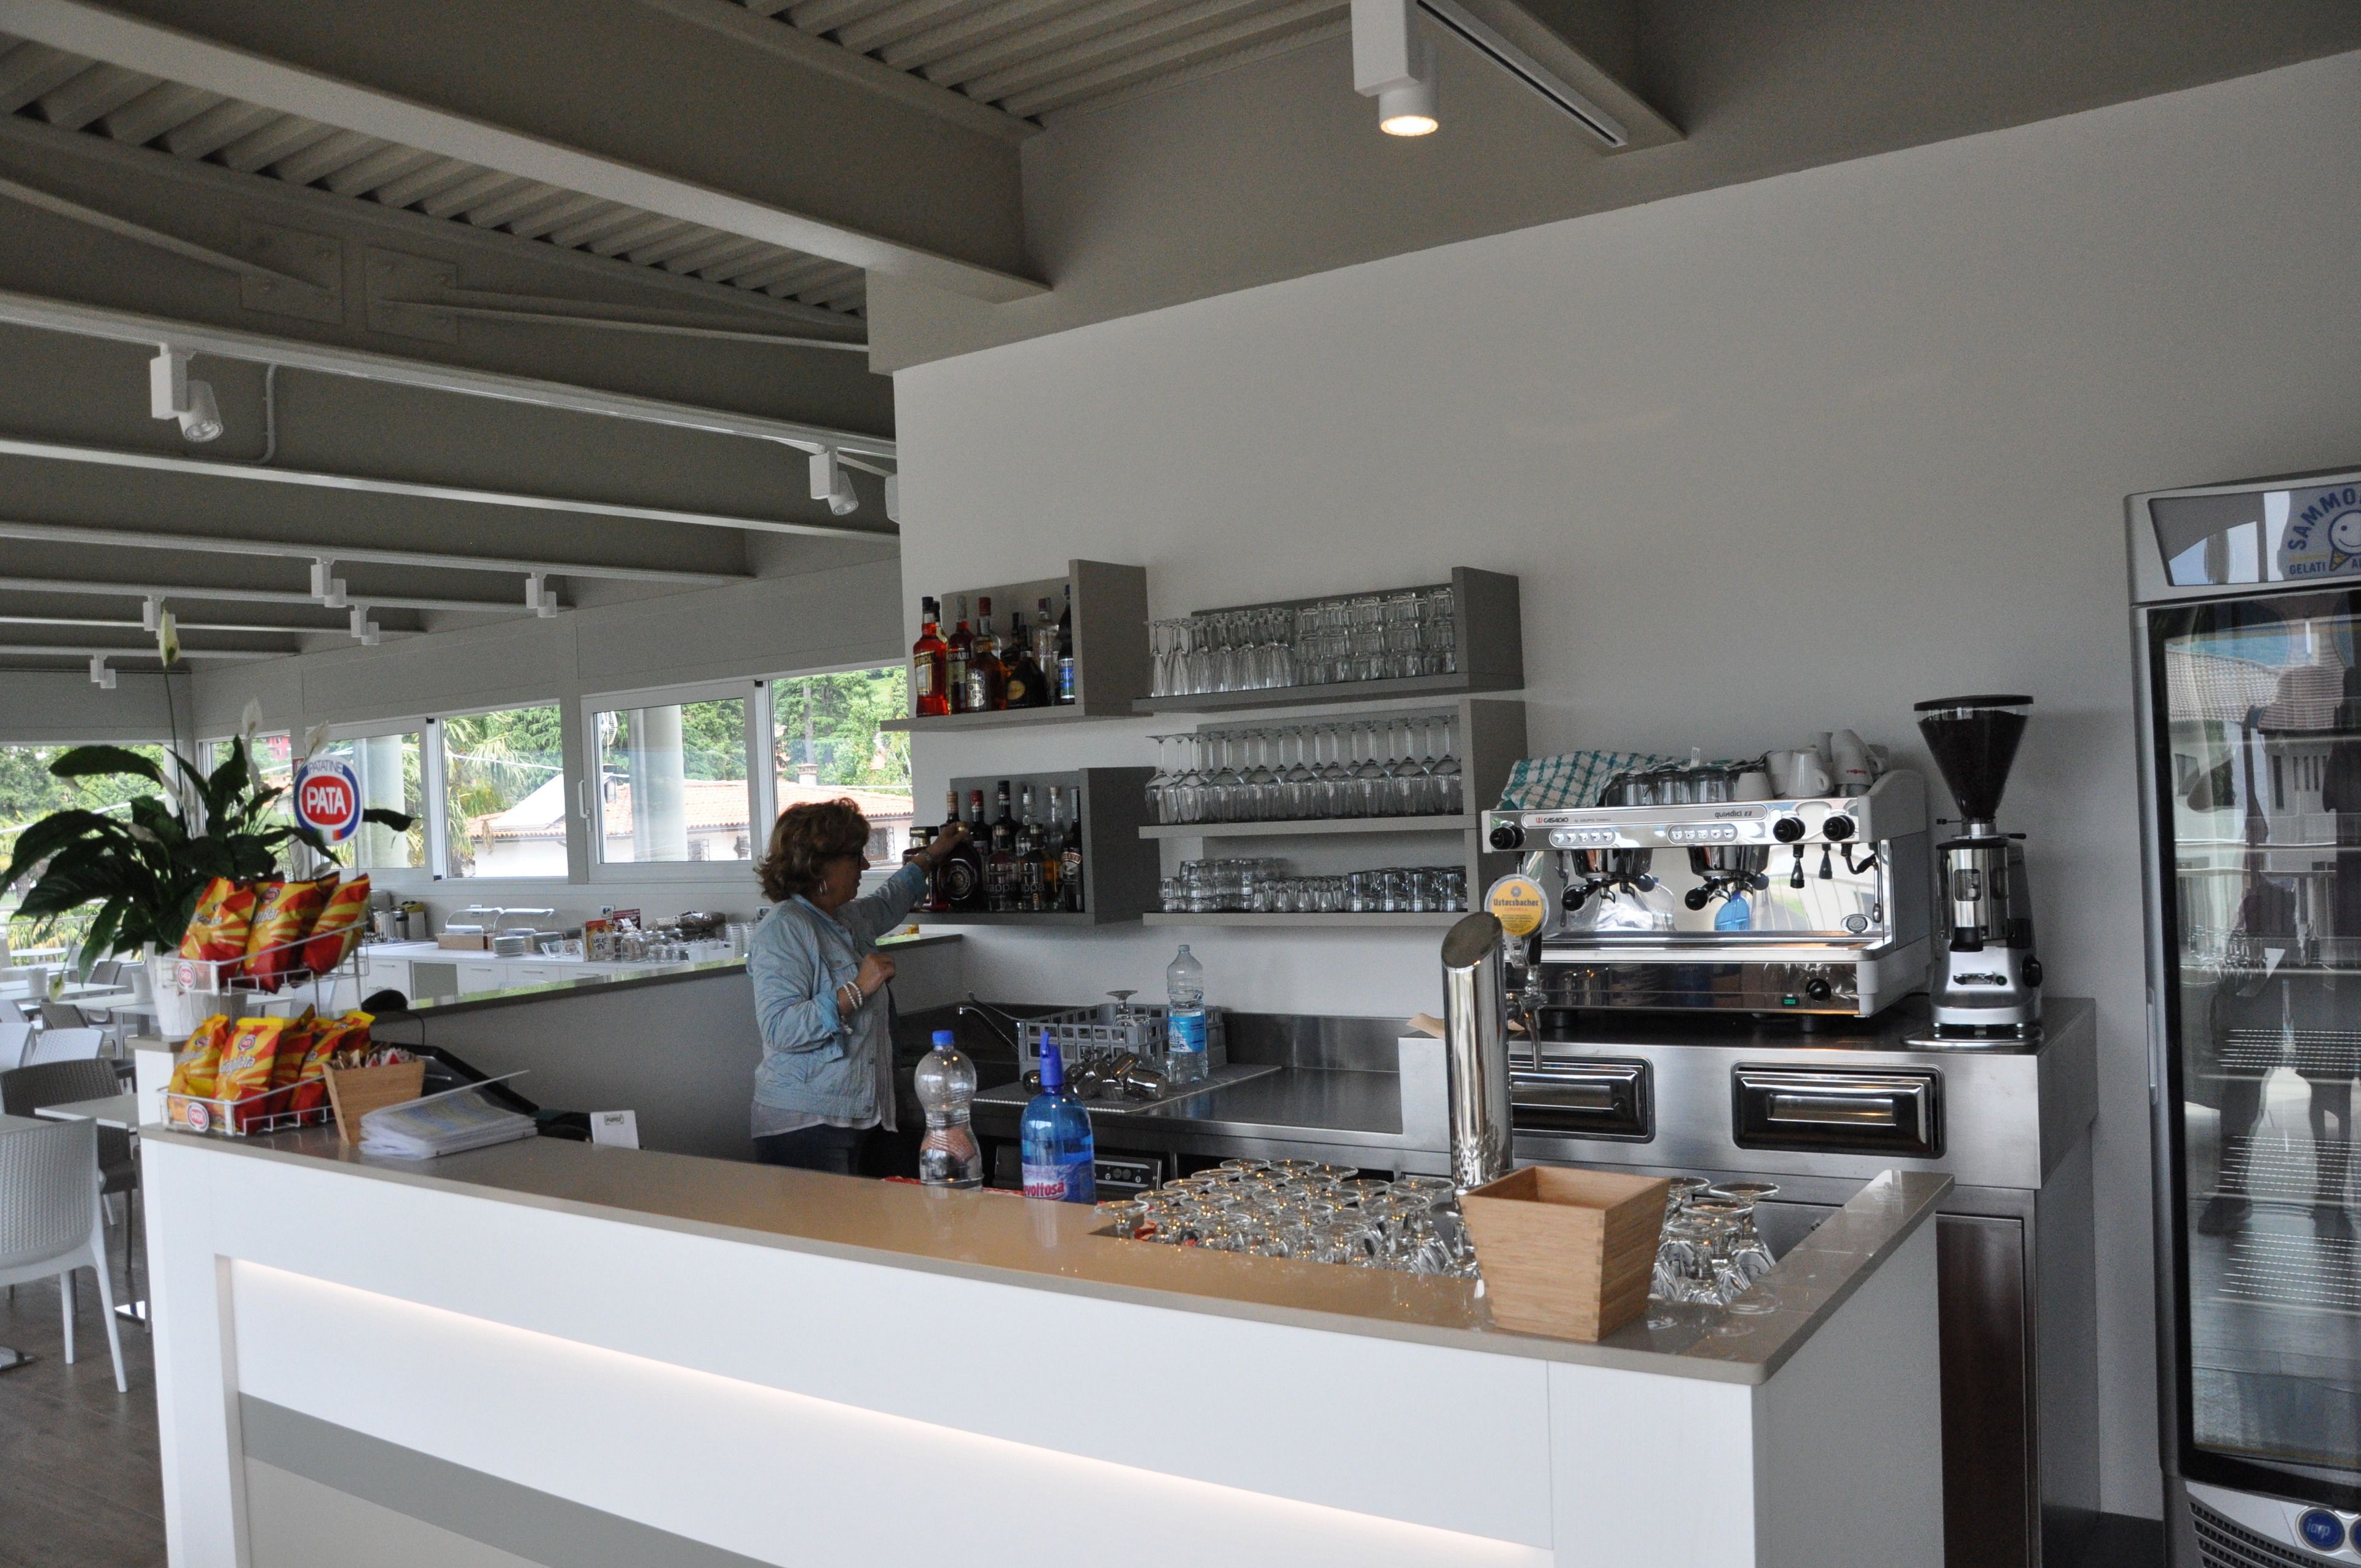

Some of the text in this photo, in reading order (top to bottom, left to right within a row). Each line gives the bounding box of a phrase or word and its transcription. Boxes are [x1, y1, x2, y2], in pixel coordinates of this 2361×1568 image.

[2287, 488, 2361, 550] SAMMO
[2289, 561, 2326, 574] GELATI
[308, 759, 343, 774] PATATINE
[307, 786, 347, 815] PATA
[1715, 810, 1742, 819] quindici
